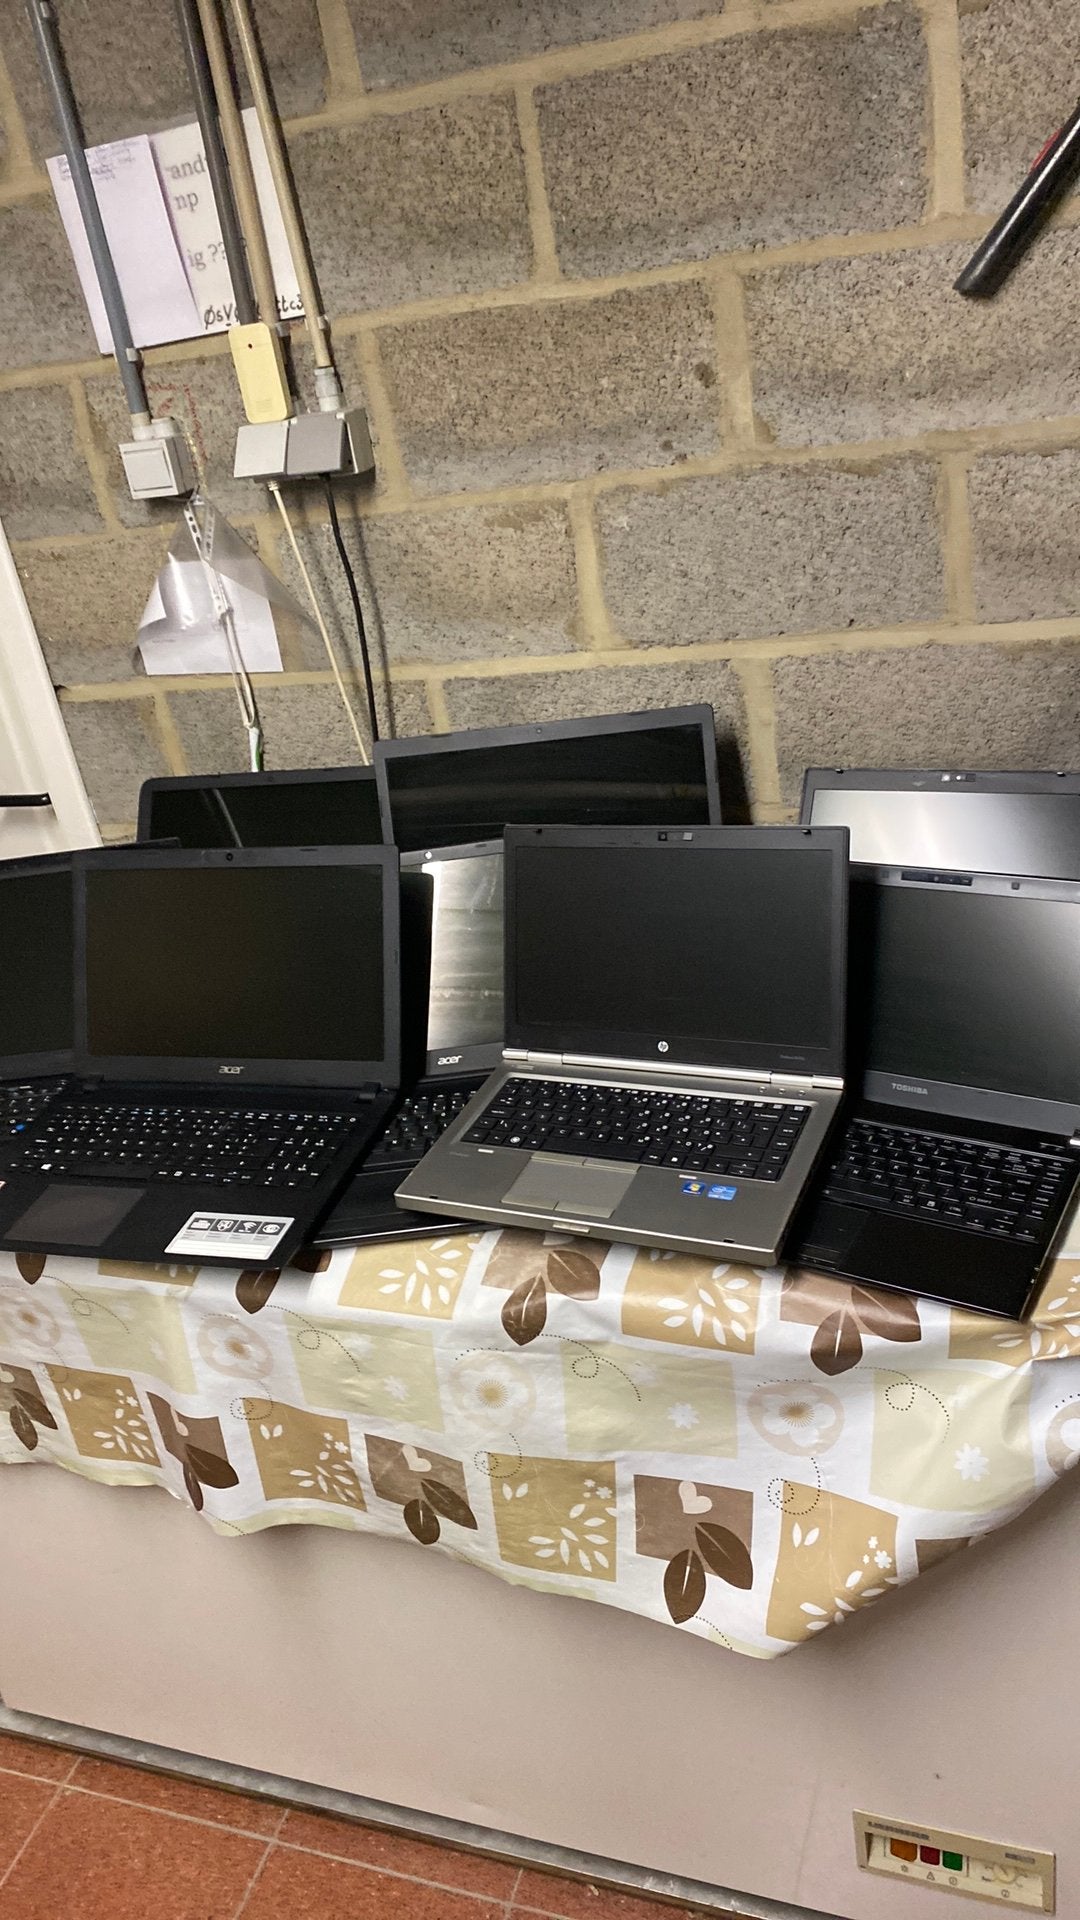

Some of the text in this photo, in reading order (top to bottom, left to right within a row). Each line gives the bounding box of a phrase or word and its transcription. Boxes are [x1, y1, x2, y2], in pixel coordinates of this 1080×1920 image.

[437, 1054, 463, 1066] acer
[218, 1065, 245, 1075] acer
[891, 1082, 928, 1095] TOSHIBA
